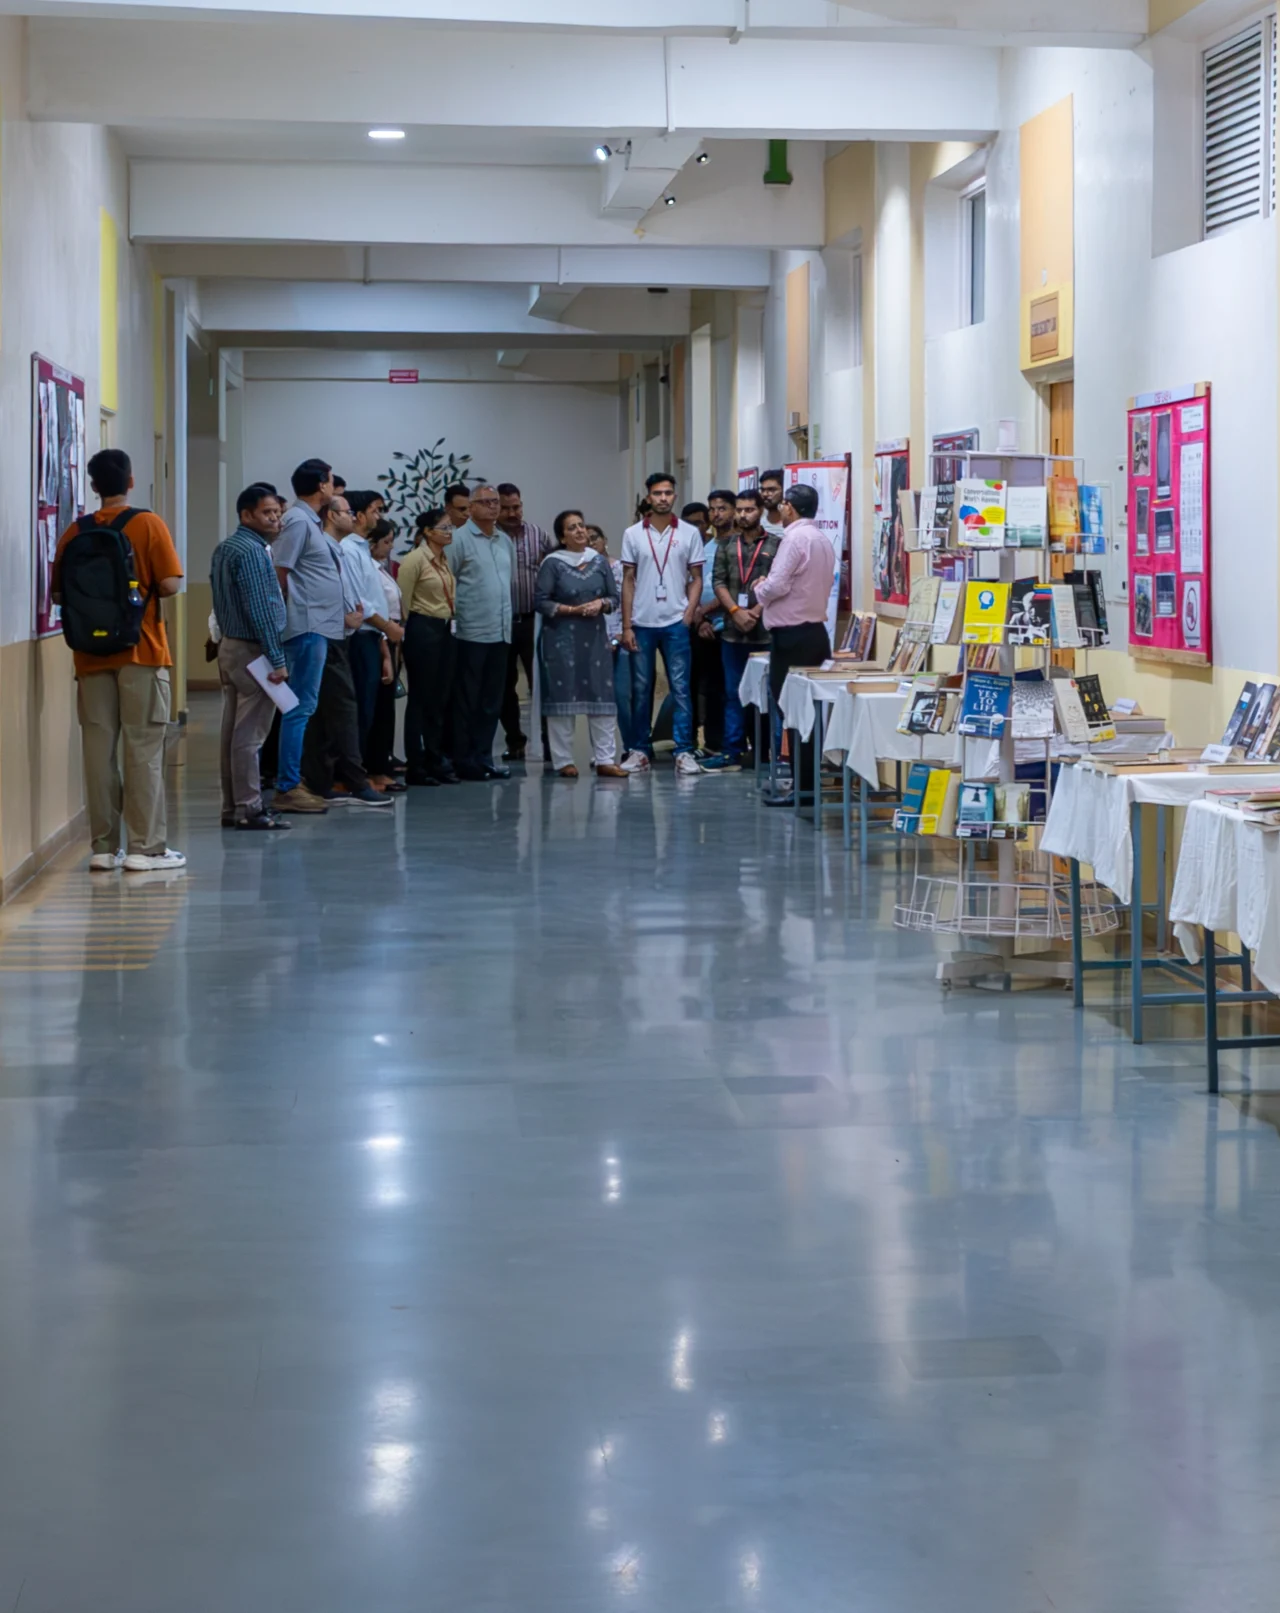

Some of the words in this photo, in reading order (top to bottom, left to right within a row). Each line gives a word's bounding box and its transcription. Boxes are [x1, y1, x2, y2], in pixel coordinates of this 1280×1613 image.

[978, 689, 998, 699] YES
[980, 697, 994, 705] TO
[972, 703, 998, 713] LIFE
